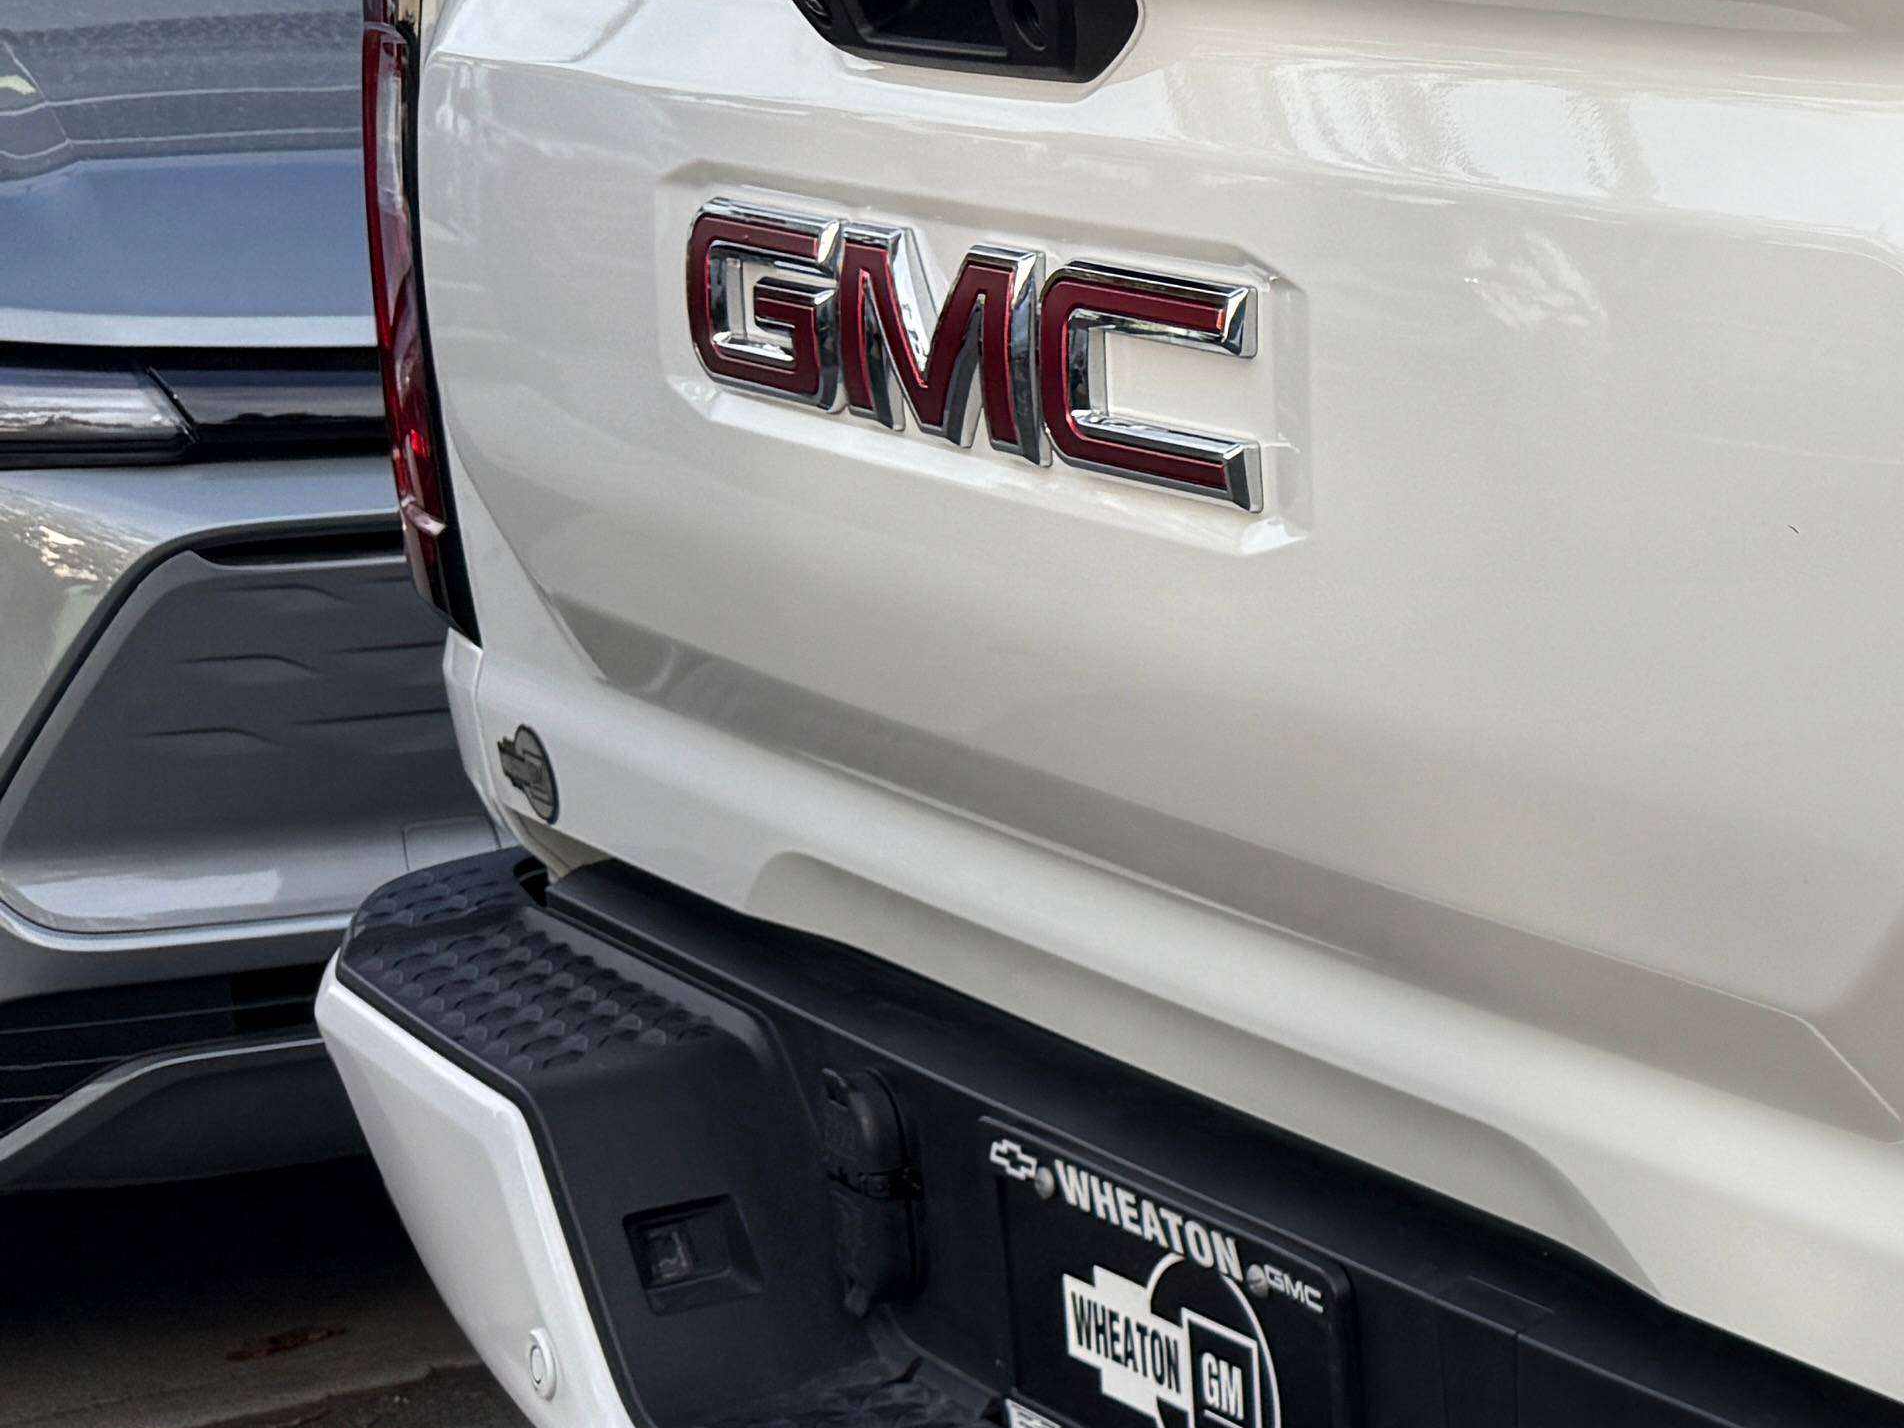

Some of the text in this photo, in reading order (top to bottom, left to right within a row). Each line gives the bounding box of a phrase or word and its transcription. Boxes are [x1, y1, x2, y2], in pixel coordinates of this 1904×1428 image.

[687, 196, 1263, 513] GMC
[1055, 1159, 1244, 1283] WHEATON
[1264, 1264, 1323, 1313] GMC
[1071, 1290, 1181, 1395] WHEATON
[1201, 1351, 1245, 1420] GM
